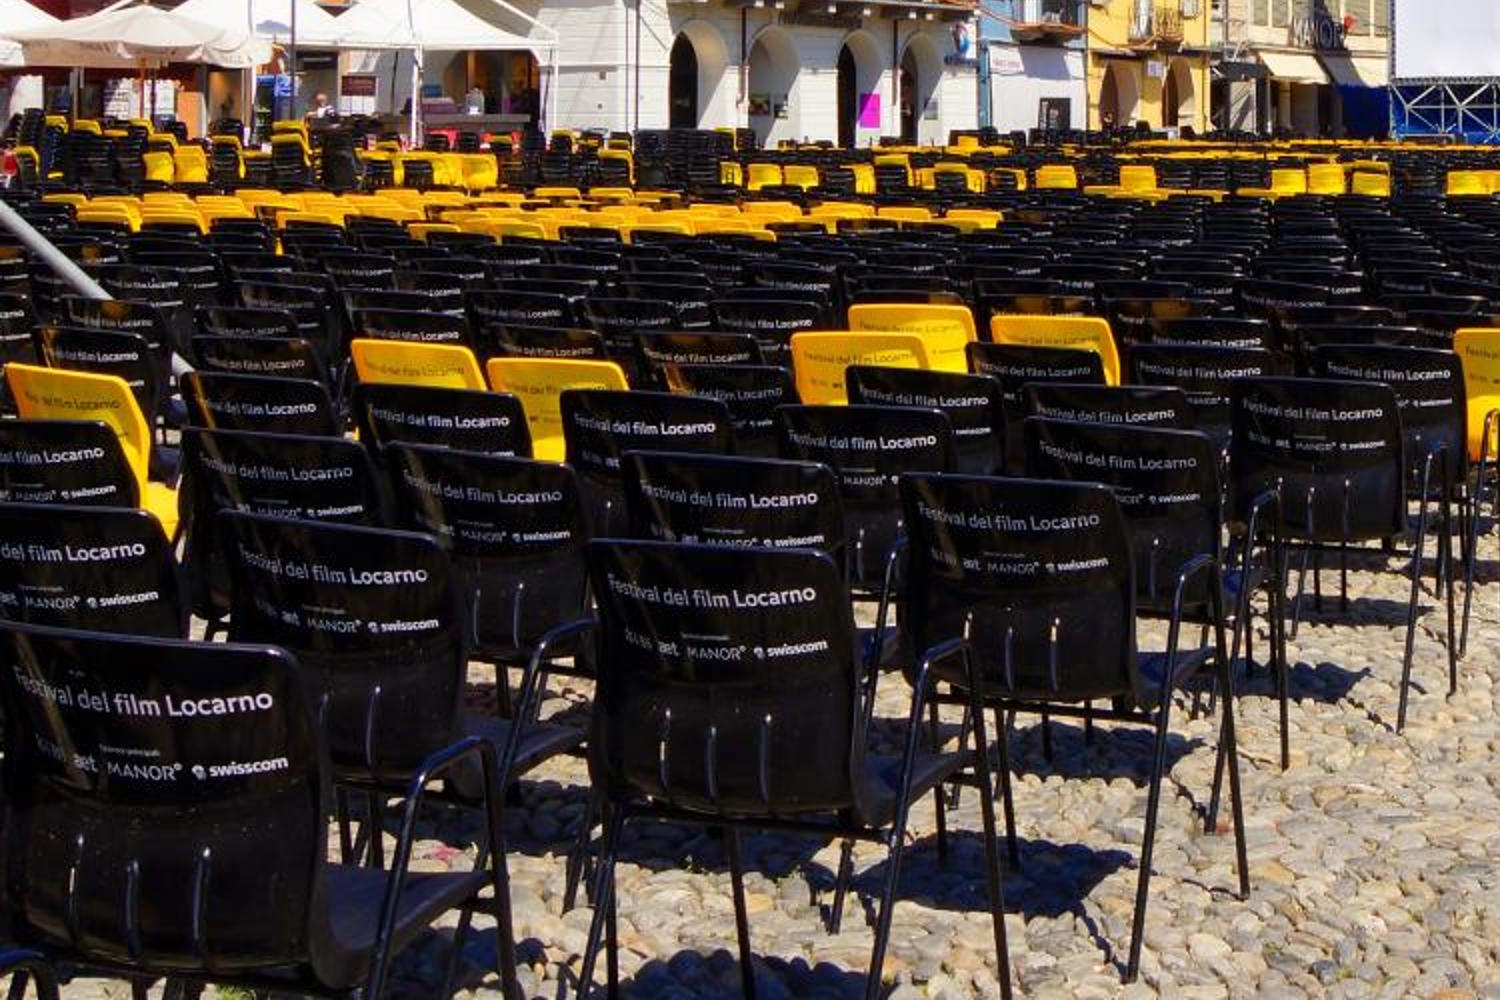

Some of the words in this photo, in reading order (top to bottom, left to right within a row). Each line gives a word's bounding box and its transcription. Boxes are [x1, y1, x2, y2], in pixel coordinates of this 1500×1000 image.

[1049, 366, 1091, 378] Locarno
[1217, 366, 1261, 378] Locarno
[1406, 369, 1450, 381] Locarno
[737, 387, 782, 400] Locarno
[265, 402, 317, 415] Locarno
[940, 395, 989, 408] Locarno
[1125, 409, 1175, 423] Locarno
[1305, 407, 1329, 420] film
[1332, 407, 1383, 421] Locarno
[455, 414, 509, 429] Locarno
[661, 421, 717, 435] Locarno
[880, 436, 937, 450] Locarno
[43, 447, 104, 464] Locarno
[1085, 454, 1107, 469] del
[1108, 455, 1136, 471] film
[1138, 455, 1197, 471] Locarno
[291, 467, 353, 481] Locarno
[499, 490, 562, 504] Locarno
[716, 493, 747, 508] film
[751, 493, 818, 509] Locarno
[968, 513, 992, 530] del
[994, 514, 1027, 531] film
[1030, 513, 1100, 531] Locarno
[29, 546, 63, 562] film
[65, 543, 146, 561] Locarno
[311, 565, 347, 583] film
[350, 568, 428, 584] Locarno
[99, 591, 159, 607] swisscom
[663, 590, 690, 606] del
[693, 590, 730, 608] film
[733, 587, 817, 607] Locarno
[381, 618, 439, 632] swisscom
[767, 640, 828, 657] swisscom
[77, 692, 111, 713] del
[113, 693, 161, 716] film
[165, 693, 273, 717] Locarno
[208, 756, 289, 778] swisscom
